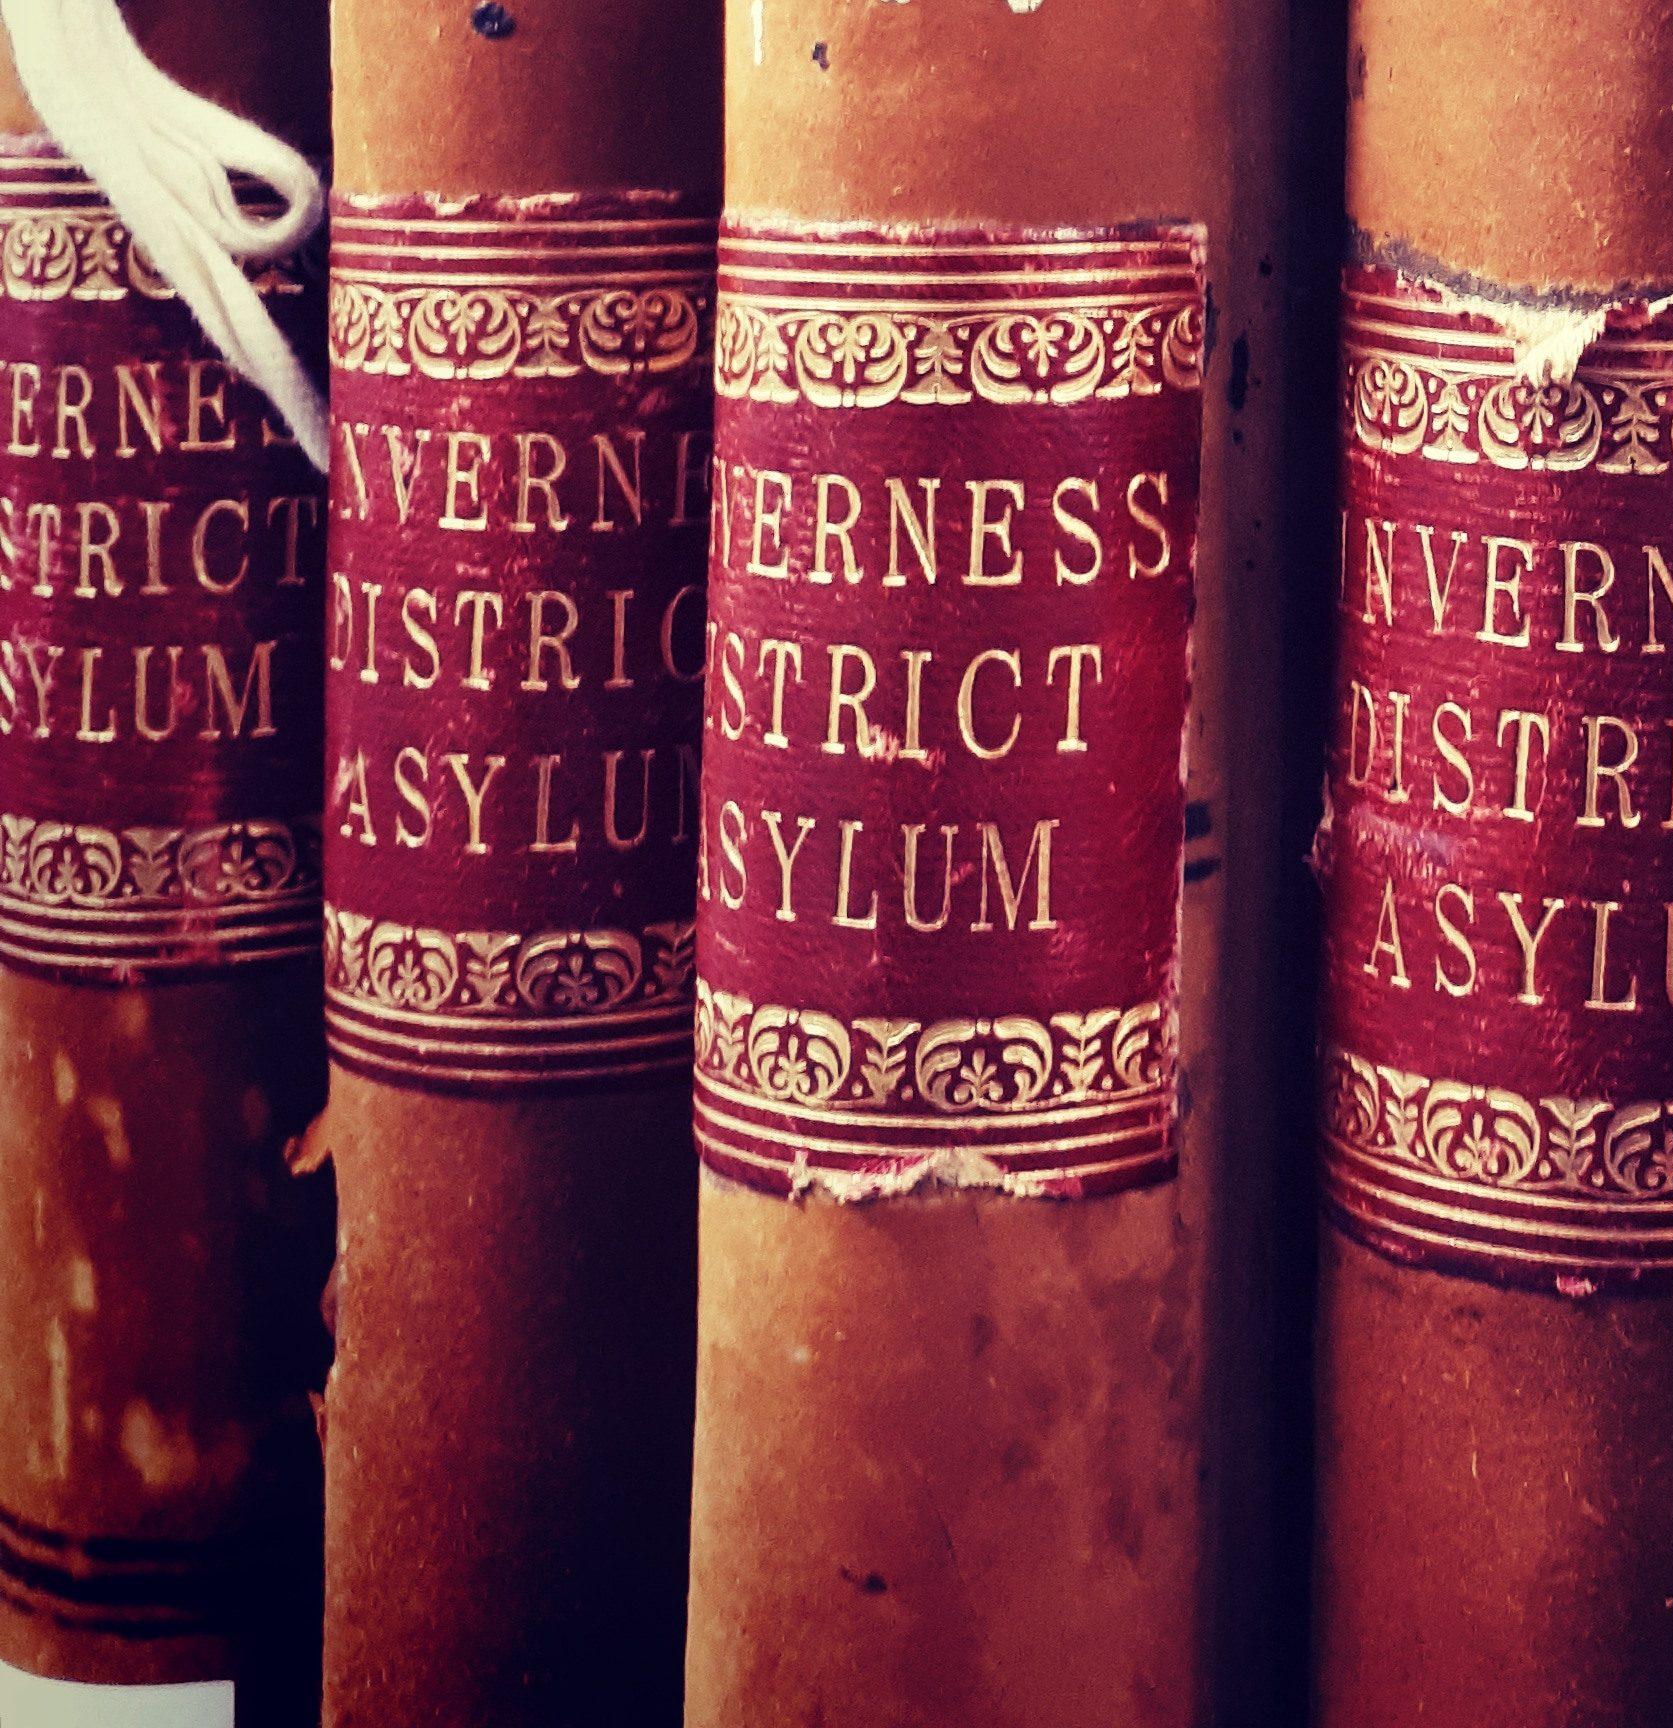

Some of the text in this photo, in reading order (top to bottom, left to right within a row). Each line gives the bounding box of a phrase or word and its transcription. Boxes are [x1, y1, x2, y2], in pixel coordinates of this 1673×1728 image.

[0, 359, 296, 460] ERNE
[711, 456, 1172, 588] VERNESS
[701, 792, 1060, 934] SYLUM
